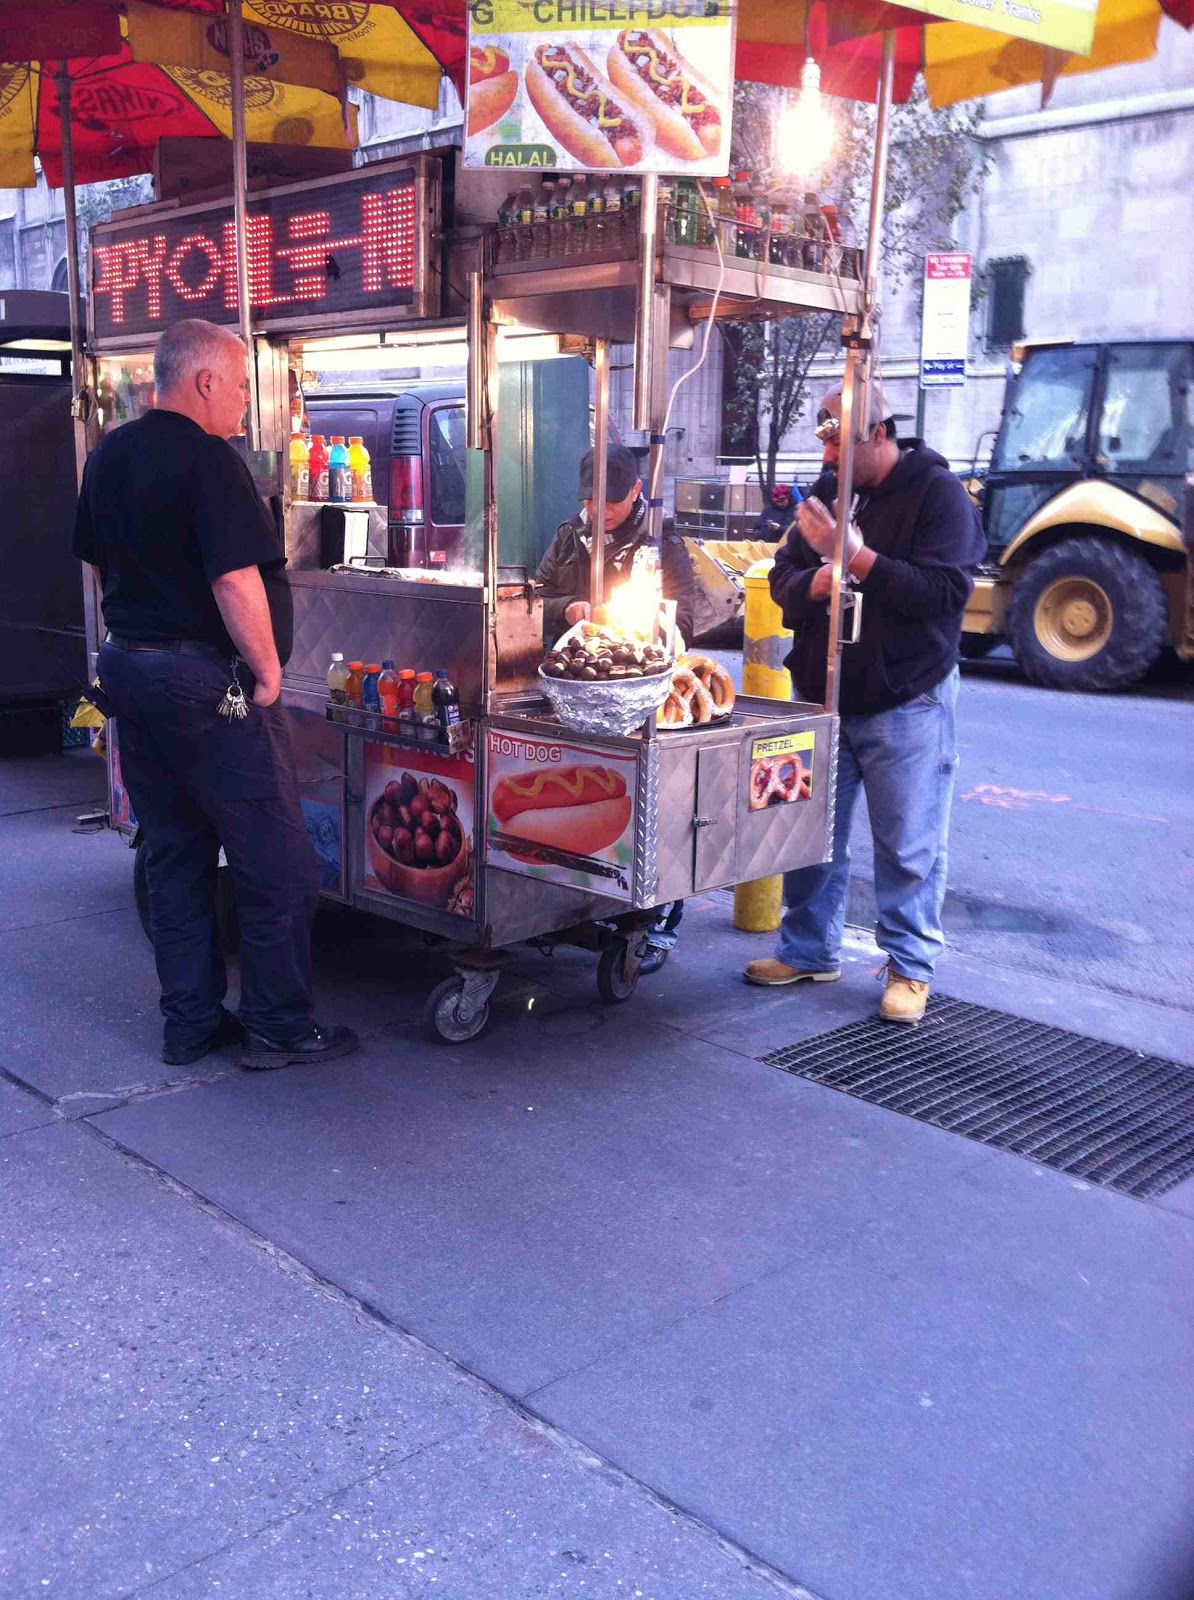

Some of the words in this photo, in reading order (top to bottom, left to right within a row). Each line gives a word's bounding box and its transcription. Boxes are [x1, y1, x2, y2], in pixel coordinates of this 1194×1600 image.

[1001, 1, 1042, 24] Franks
[490, 151, 554, 167] HALAL
[490, 734, 522, 758] HOT
[525, 743, 561, 762] DOG
[756, 739, 794, 753] PRETZEL
